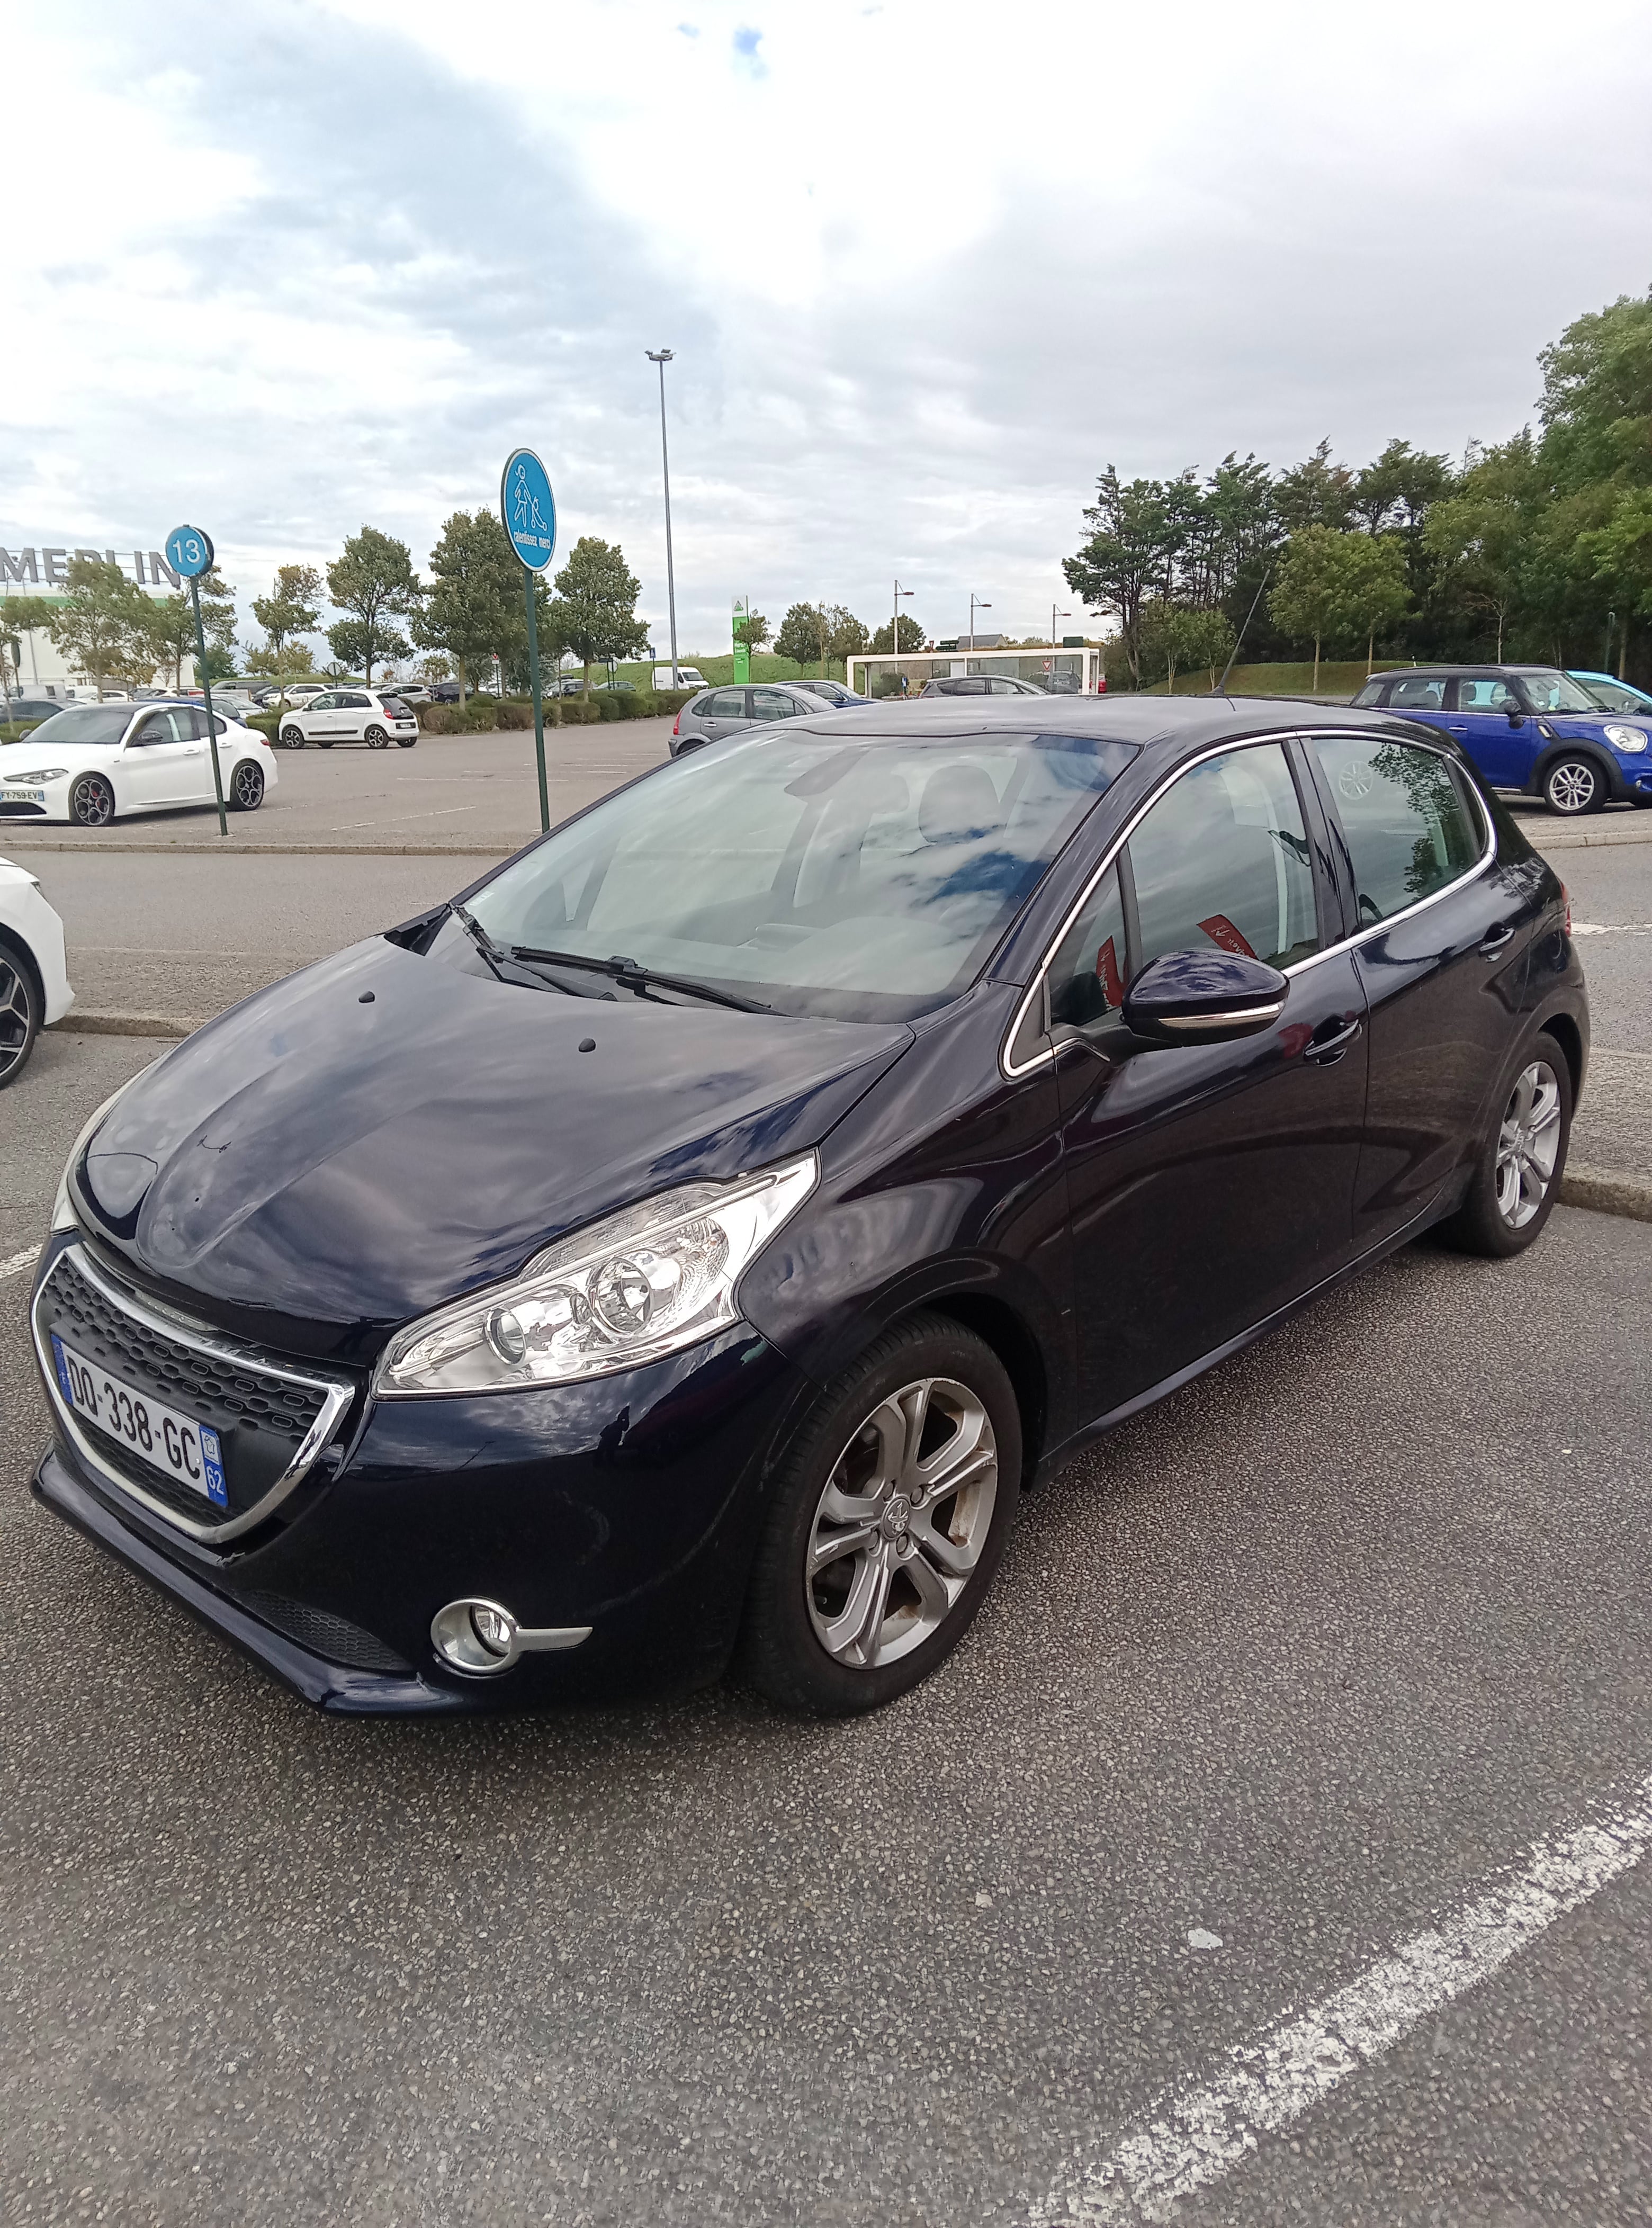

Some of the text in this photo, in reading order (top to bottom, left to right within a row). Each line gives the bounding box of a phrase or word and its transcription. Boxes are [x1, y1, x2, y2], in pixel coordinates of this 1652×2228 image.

[173, 539, 200, 563] 13
[539, 536, 551, 550] merci
[206, 1466, 224, 1495] 62
